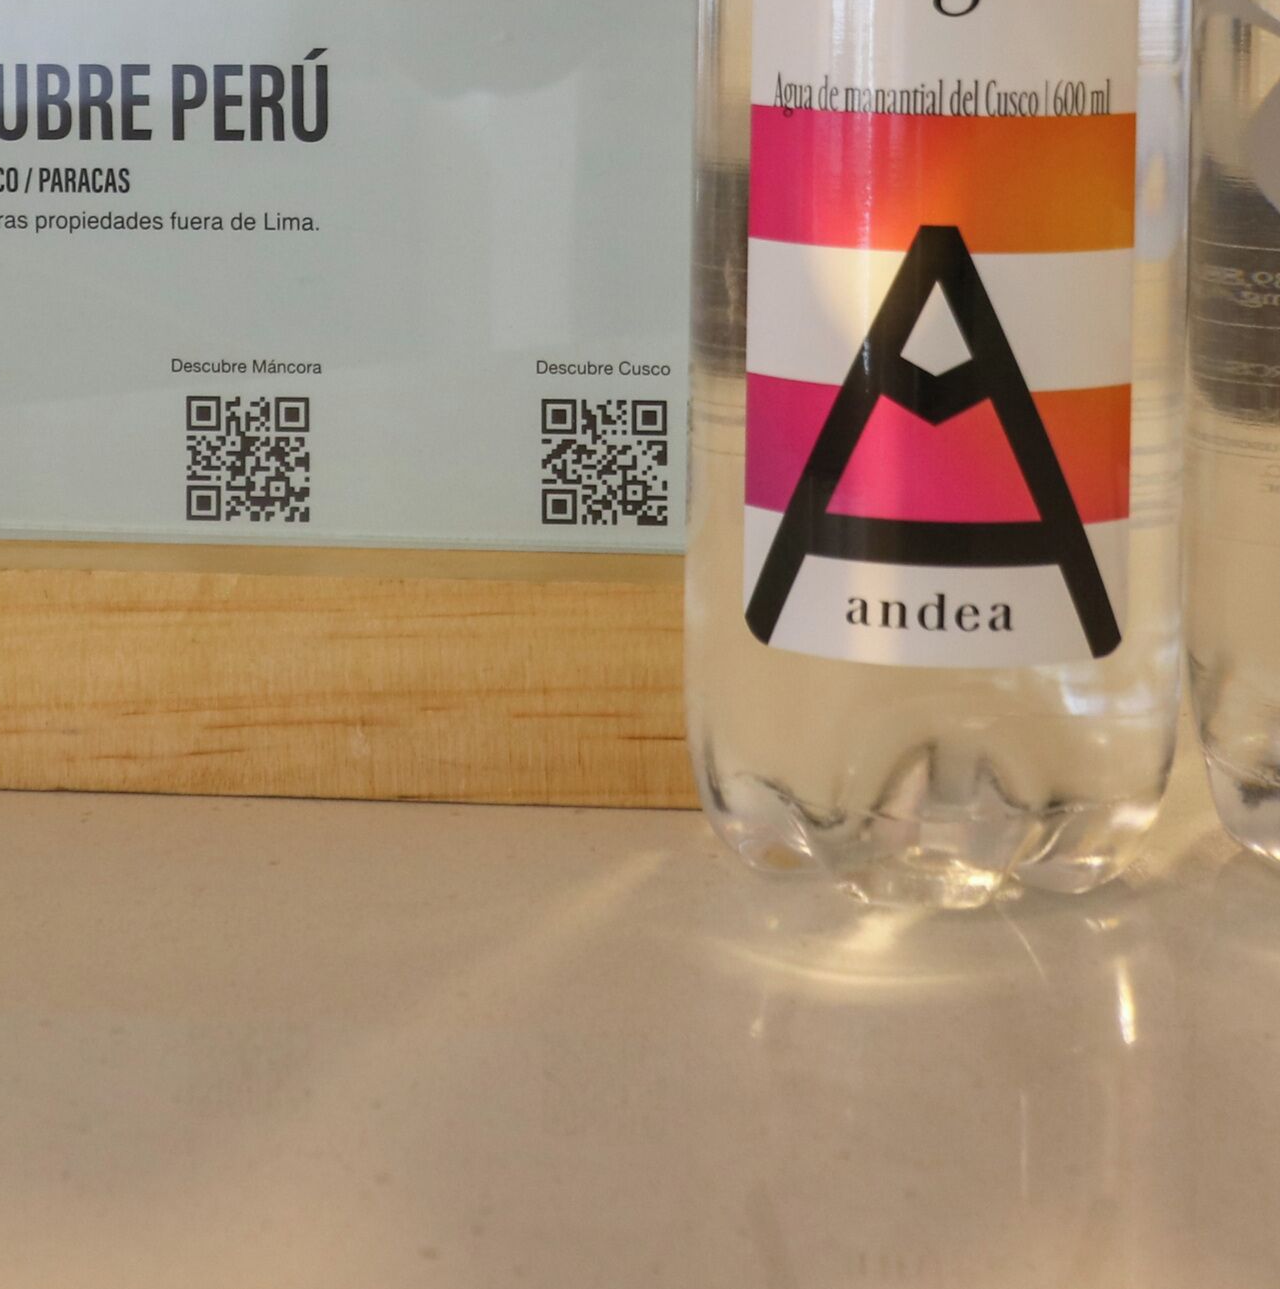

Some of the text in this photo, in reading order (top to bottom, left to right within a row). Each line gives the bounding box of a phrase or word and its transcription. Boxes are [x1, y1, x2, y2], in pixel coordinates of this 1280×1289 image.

[172, 48, 329, 142] PERÚ
[773, 71, 813, 118] Agua
[818, 75, 839, 112] de
[844, 79, 943, 116] manantial
[949, 79, 979, 117] del
[985, 79, 1039, 117] Cusco
[1053, 80, 1086, 117] 600
[1090, 78, 1110, 116] ml
[39, 168, 130, 194] PARACAS
[35, 211, 164, 234] propiedades
[170, 212, 224, 231] fuera
[230, 212, 257, 231] de
[264, 213, 320, 232] Lima.
[171, 358, 322, 375] Descubre Máncora
[536, 359, 671, 376] Descubre Cusco
[846, 593, 1014, 633] andea
